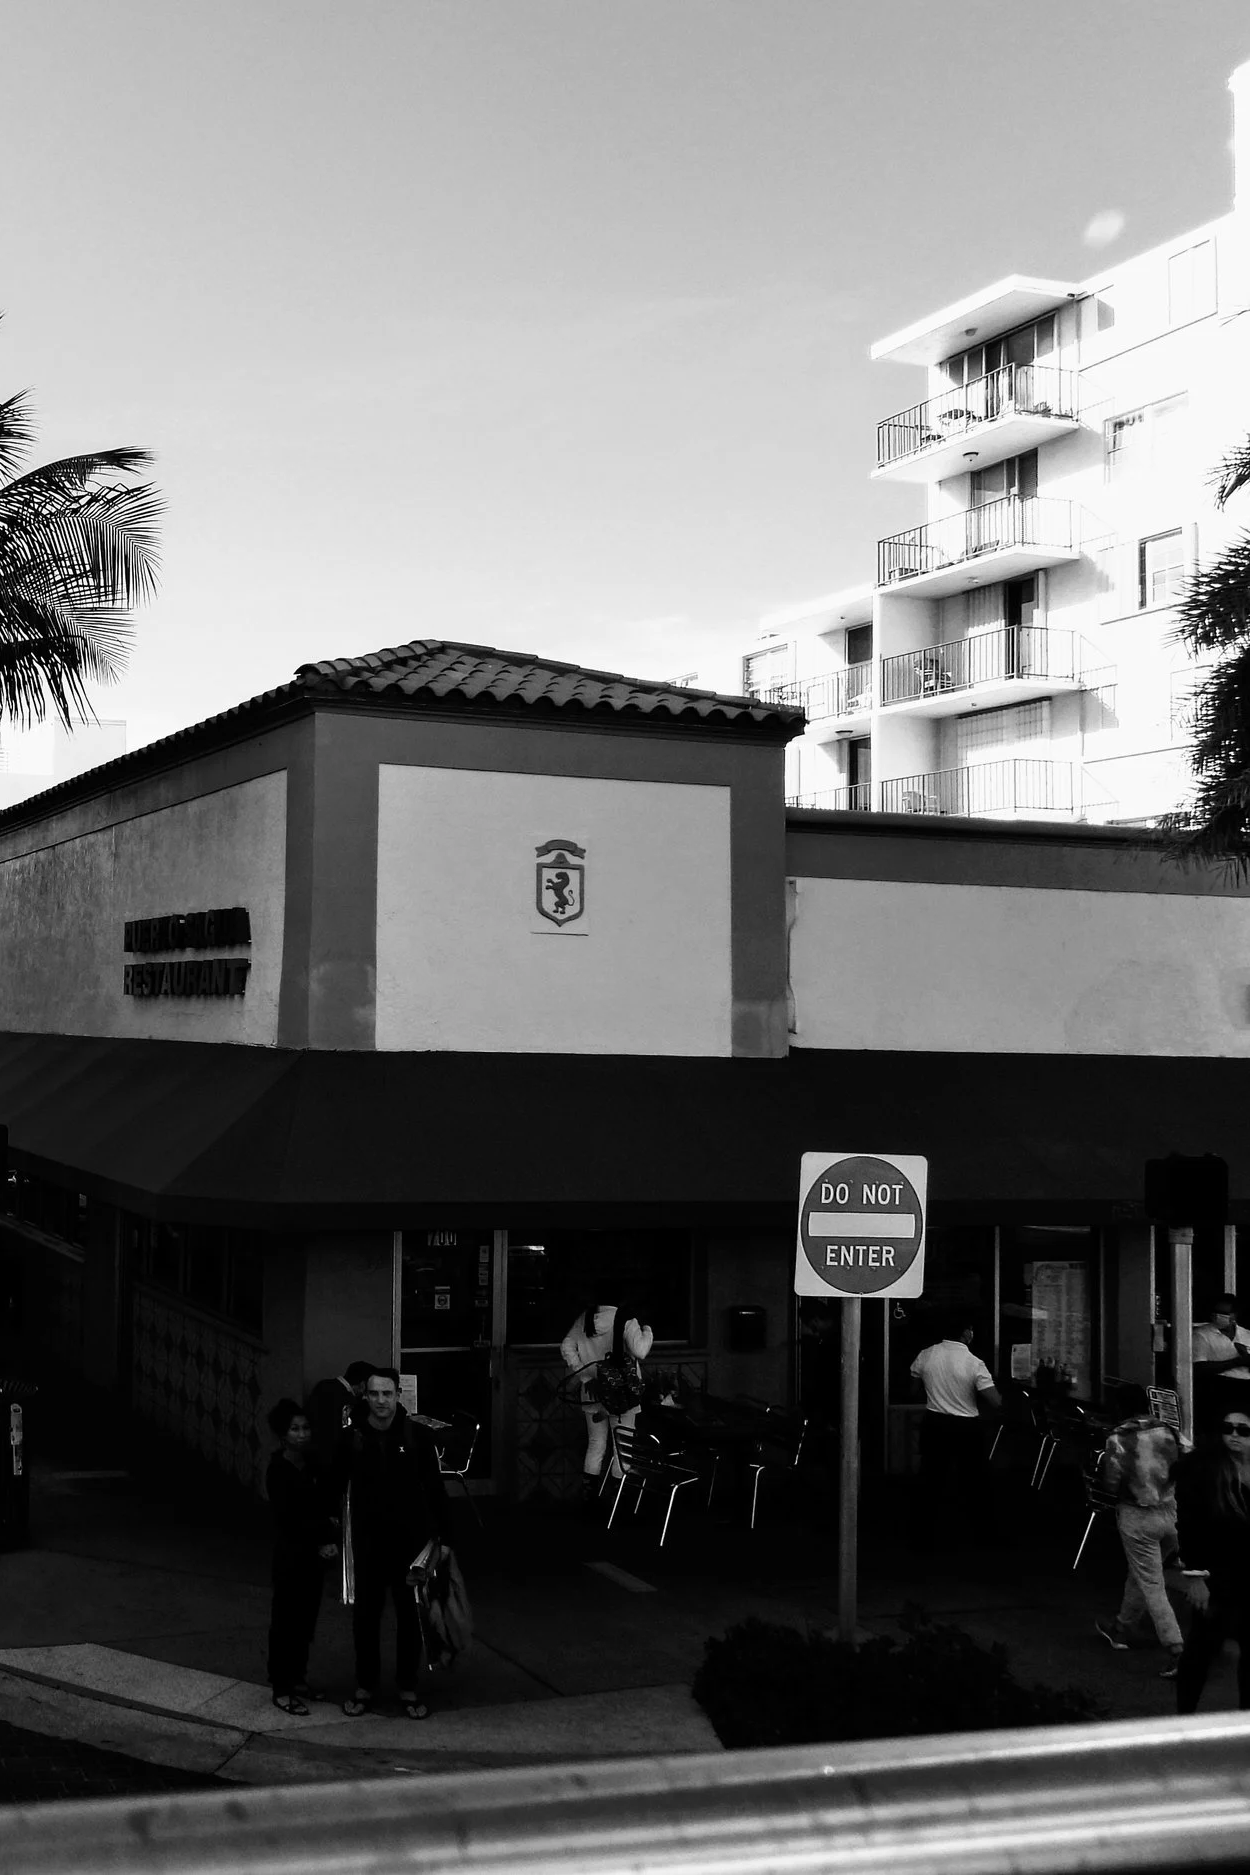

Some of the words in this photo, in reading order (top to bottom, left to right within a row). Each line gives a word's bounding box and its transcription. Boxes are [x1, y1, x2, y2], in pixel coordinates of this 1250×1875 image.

[124, 958, 249, 996] RESTAURANT
[821, 1183, 849, 1205] DO
[862, 1183, 904, 1205] NOT
[826, 1245, 895, 1267] ENTER
